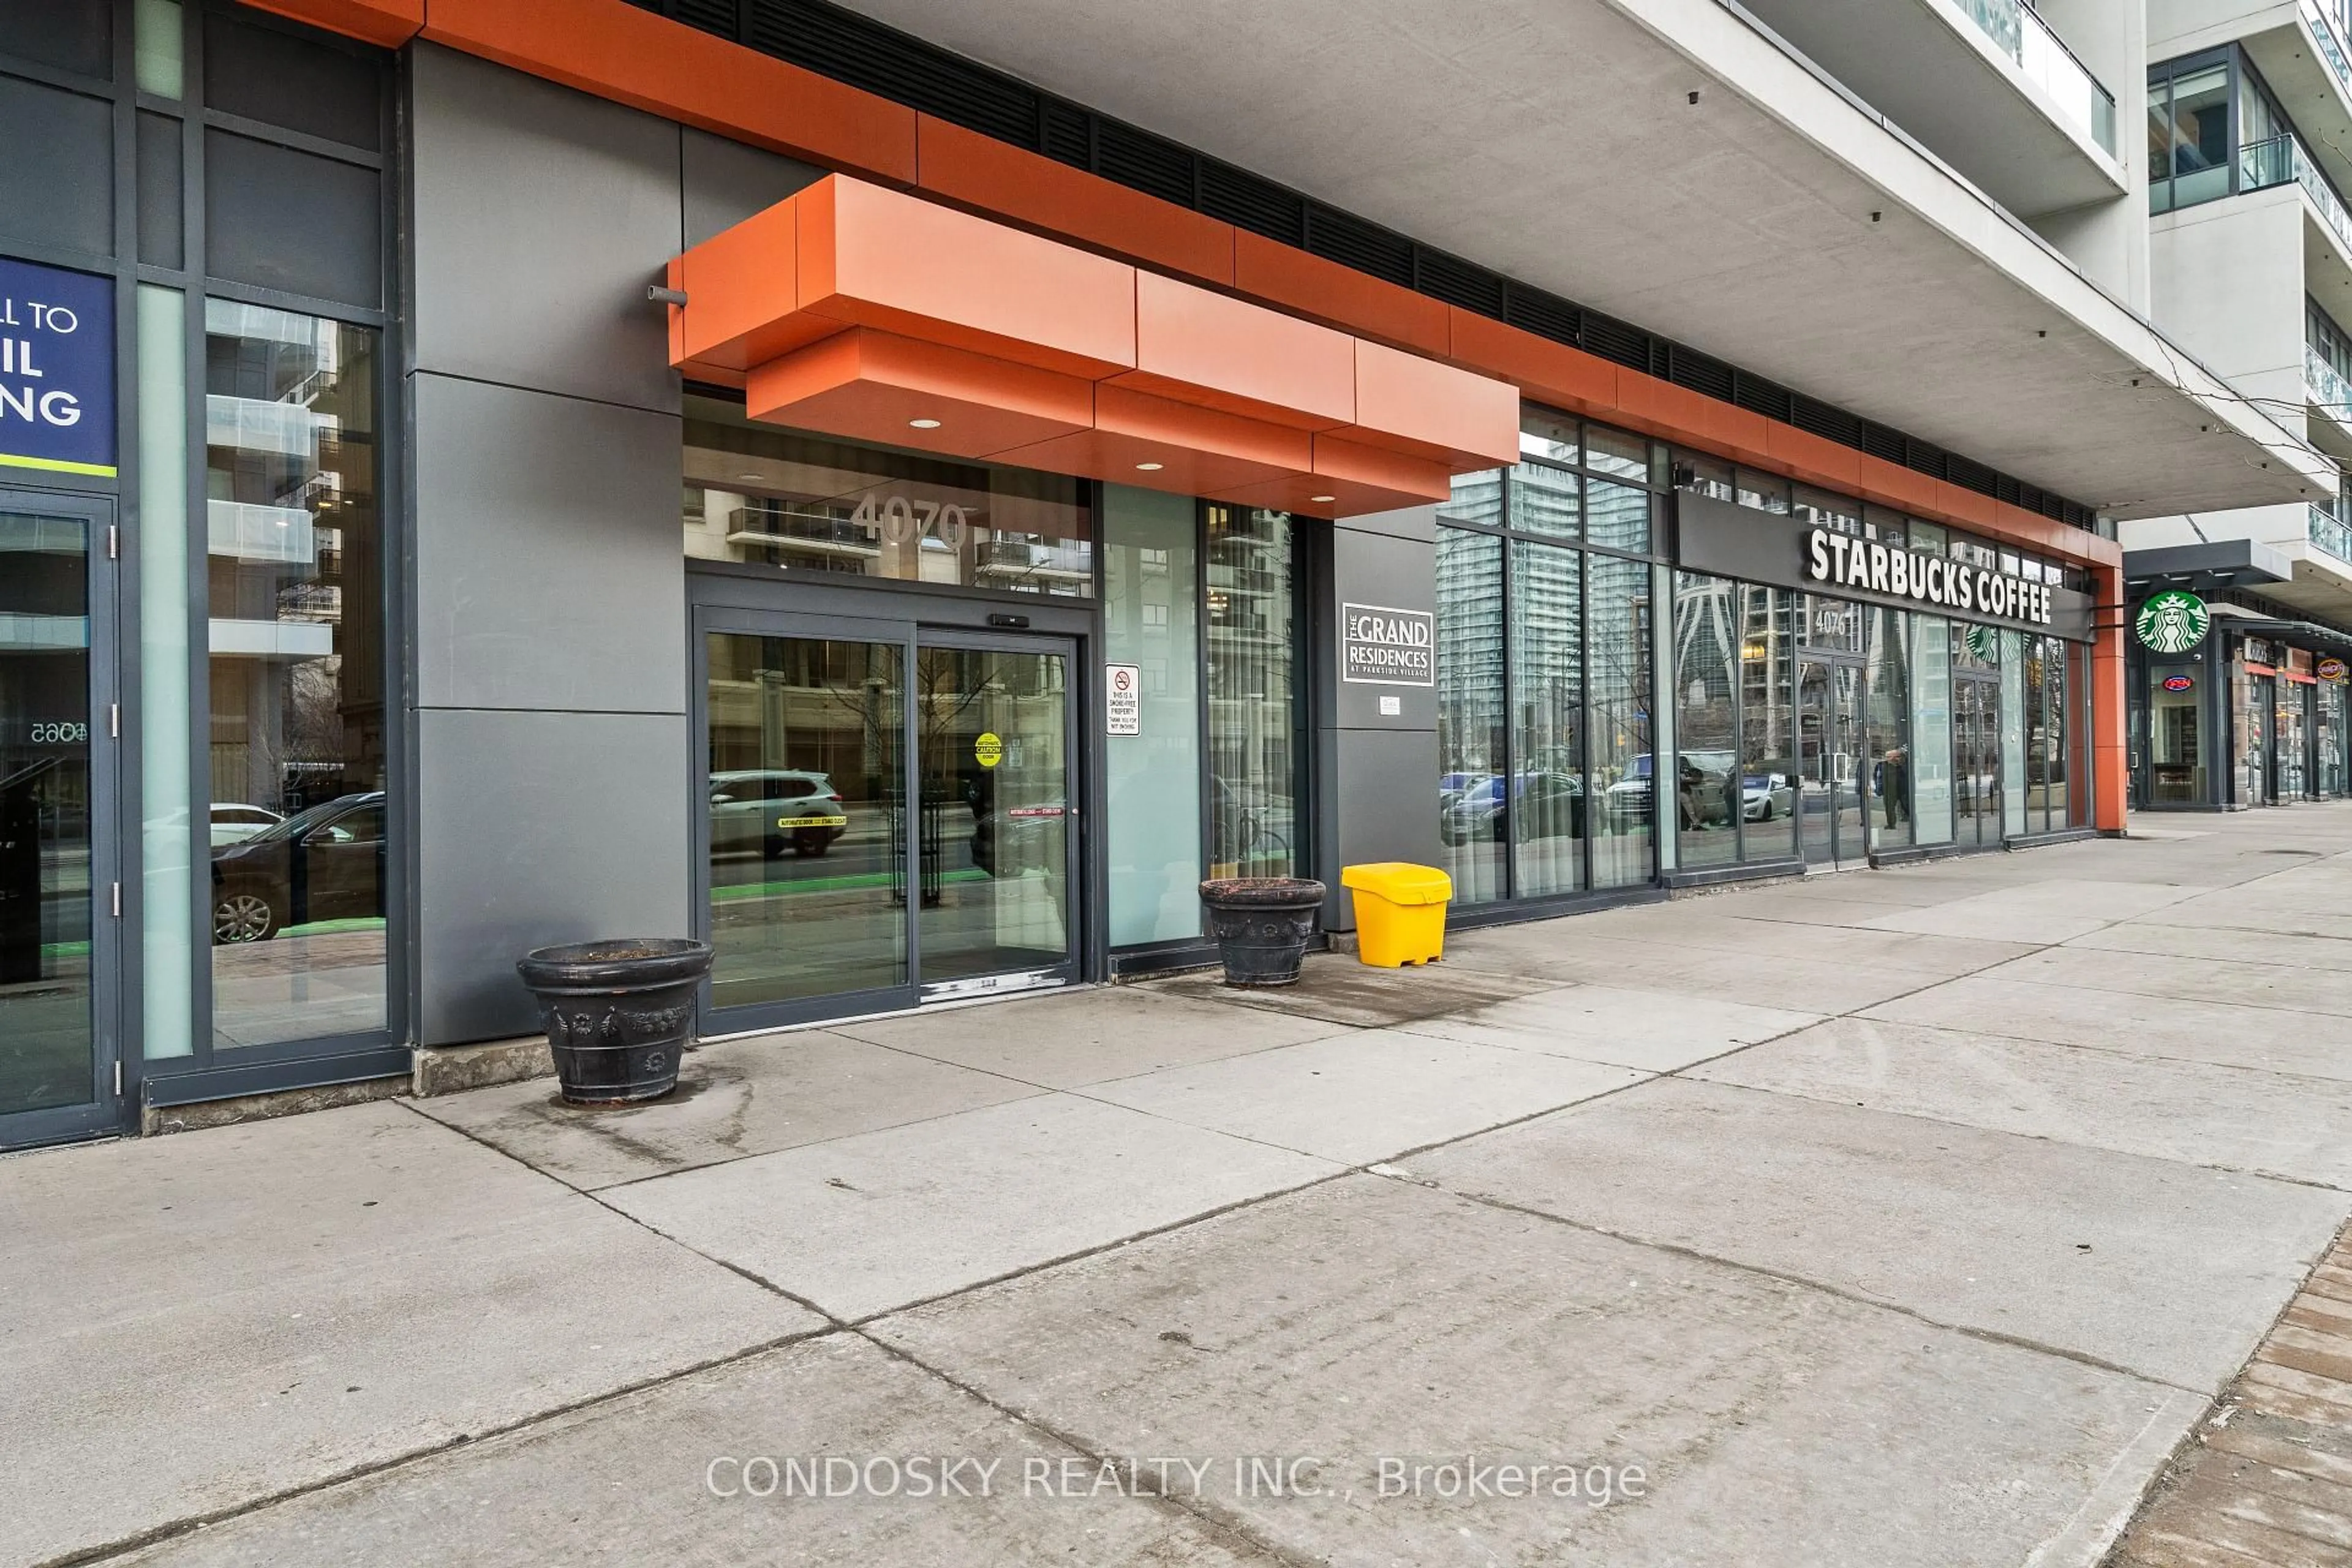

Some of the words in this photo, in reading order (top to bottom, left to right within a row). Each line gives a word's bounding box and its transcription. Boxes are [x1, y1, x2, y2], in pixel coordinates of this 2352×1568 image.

[0, 298, 20, 325] L
[28, 302, 78, 333] TO
[3, 337, 43, 377] IL
[0, 383, 81, 426] NG
[850, 492, 966, 549] 4070
[1811, 529, 1972, 609] STARBUCKS
[1977, 570, 2051, 625] COFFEE
[1357, 616, 1428, 646] GRAND
[1815, 610, 1845, 635] 4076
[1349, 646, 1428, 669] RESIDENCES
[1363, 666, 1397, 675] PARKSIDE
